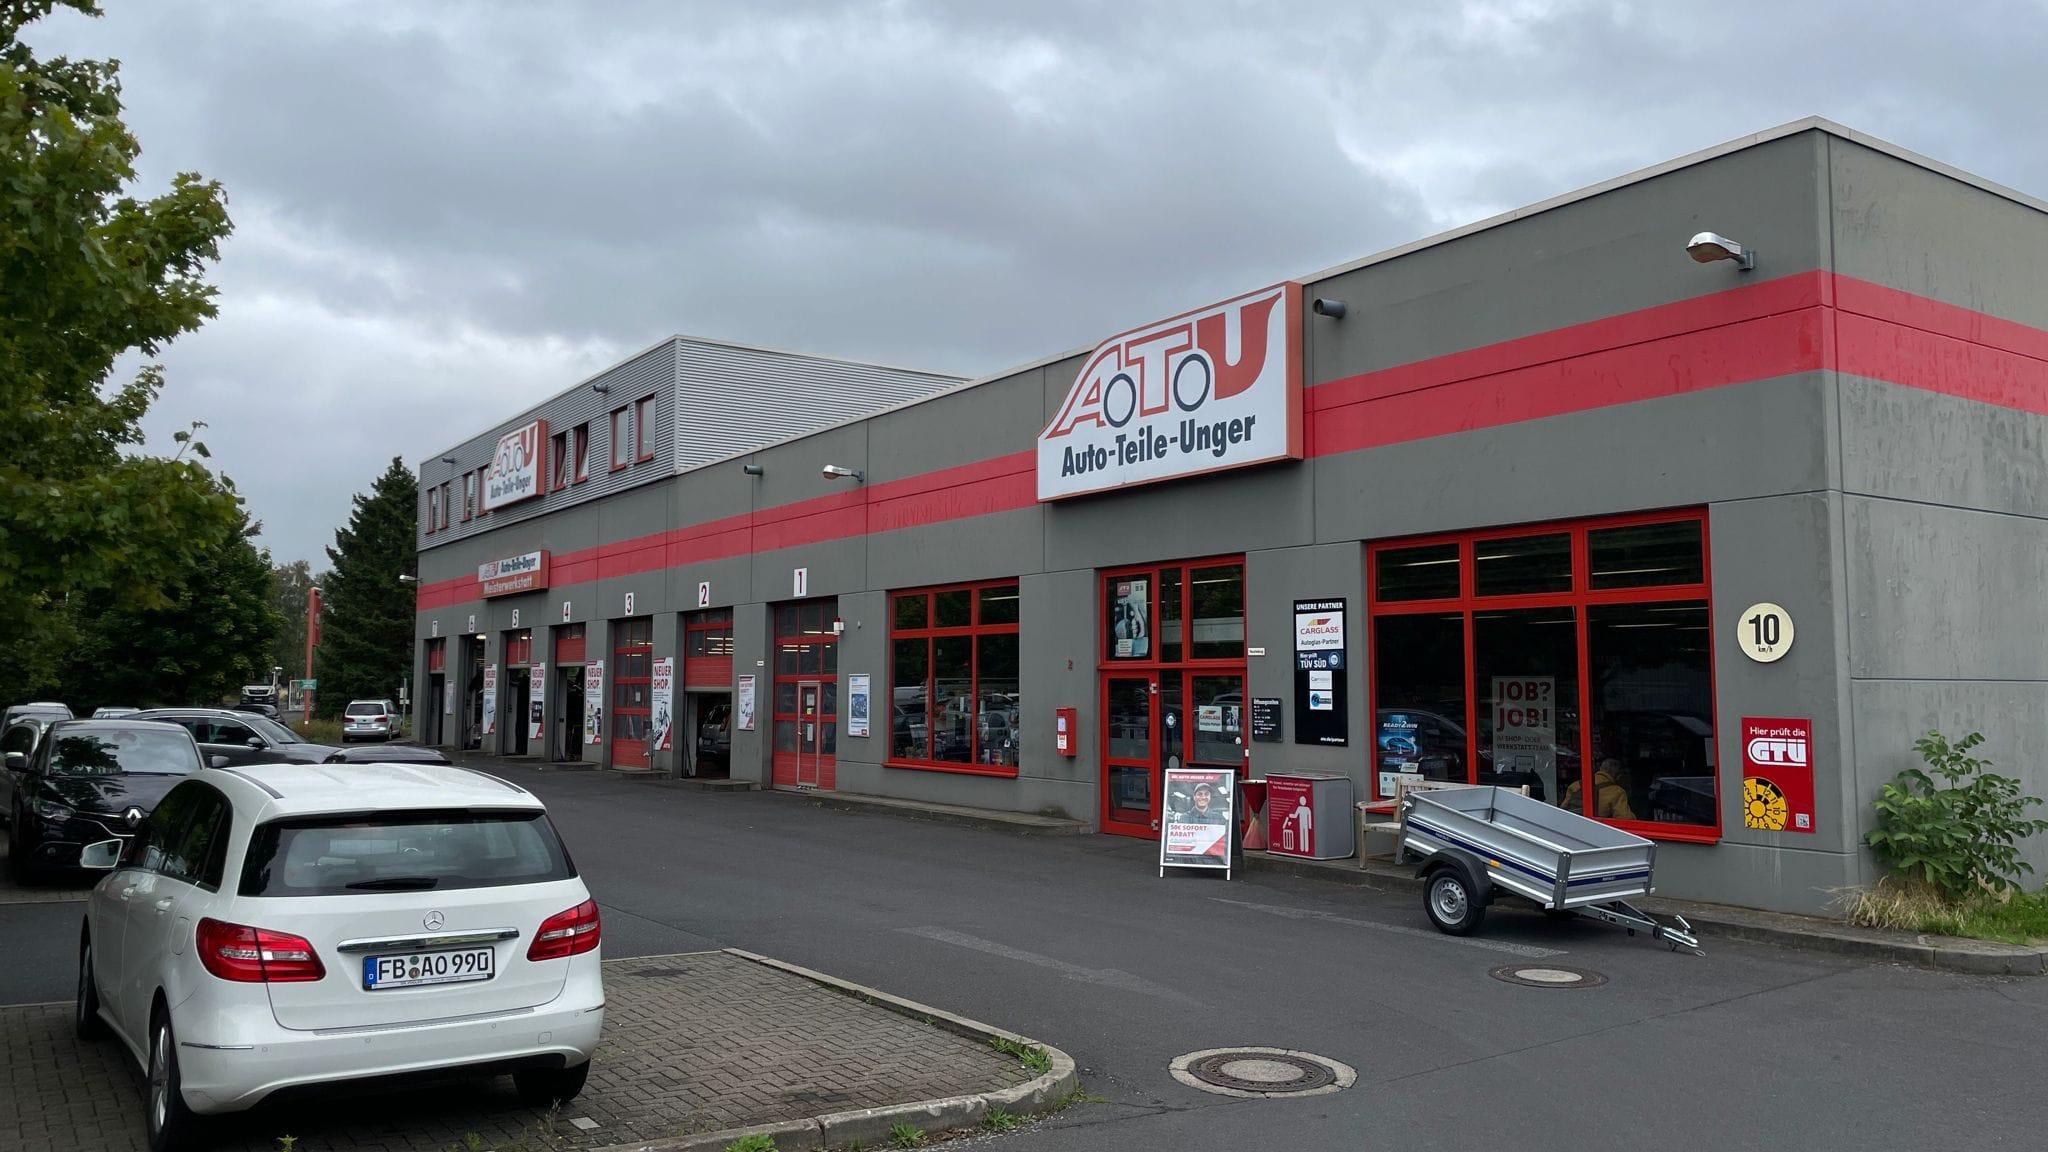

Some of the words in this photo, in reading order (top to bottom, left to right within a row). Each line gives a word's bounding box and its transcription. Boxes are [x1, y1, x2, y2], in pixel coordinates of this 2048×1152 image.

[1045, 290, 1283, 440] ATU
[1061, 414, 1256, 478] Auto-Teile-Unger
[490, 475, 532, 500] Auto-Teile-Unger
[501, 557, 536, 573] Auto-Teile-Unger
[484, 575, 533, 595] Meisterwerkstatt
[798, 571, 804, 594] 1
[701, 585, 707, 605] 2
[627, 595, 633, 614] 3
[1296, 603, 1317, 611] UNSERE
[1318, 602, 1343, 610] PARTNER
[1300, 627, 1339, 635] CARGLASS
[1749, 614, 1780, 645] 10
[1300, 639, 1339, 647] Autoglas-Partner
[1758, 645, 1773, 653] km/h
[654, 665, 671, 676] NEUER
[1301, 658, 1313, 669] TÜV
[1313, 658, 1327, 669] SÜD
[588, 667, 602, 678] NEUER
[653, 679, 670, 690] SHOP.
[1496, 681, 1551, 706] JOB?
[1496, 708, 1548, 732] JOB!
[1750, 727, 1768, 735] Hier
[1770, 728, 1791, 737] prüft
[1792, 728, 1806, 736] die
[1772, 807, 1780, 815] 10
[378, 959, 405, 980] FB
[421, 956, 448, 977] AO
[451, 951, 489, 974] 990
